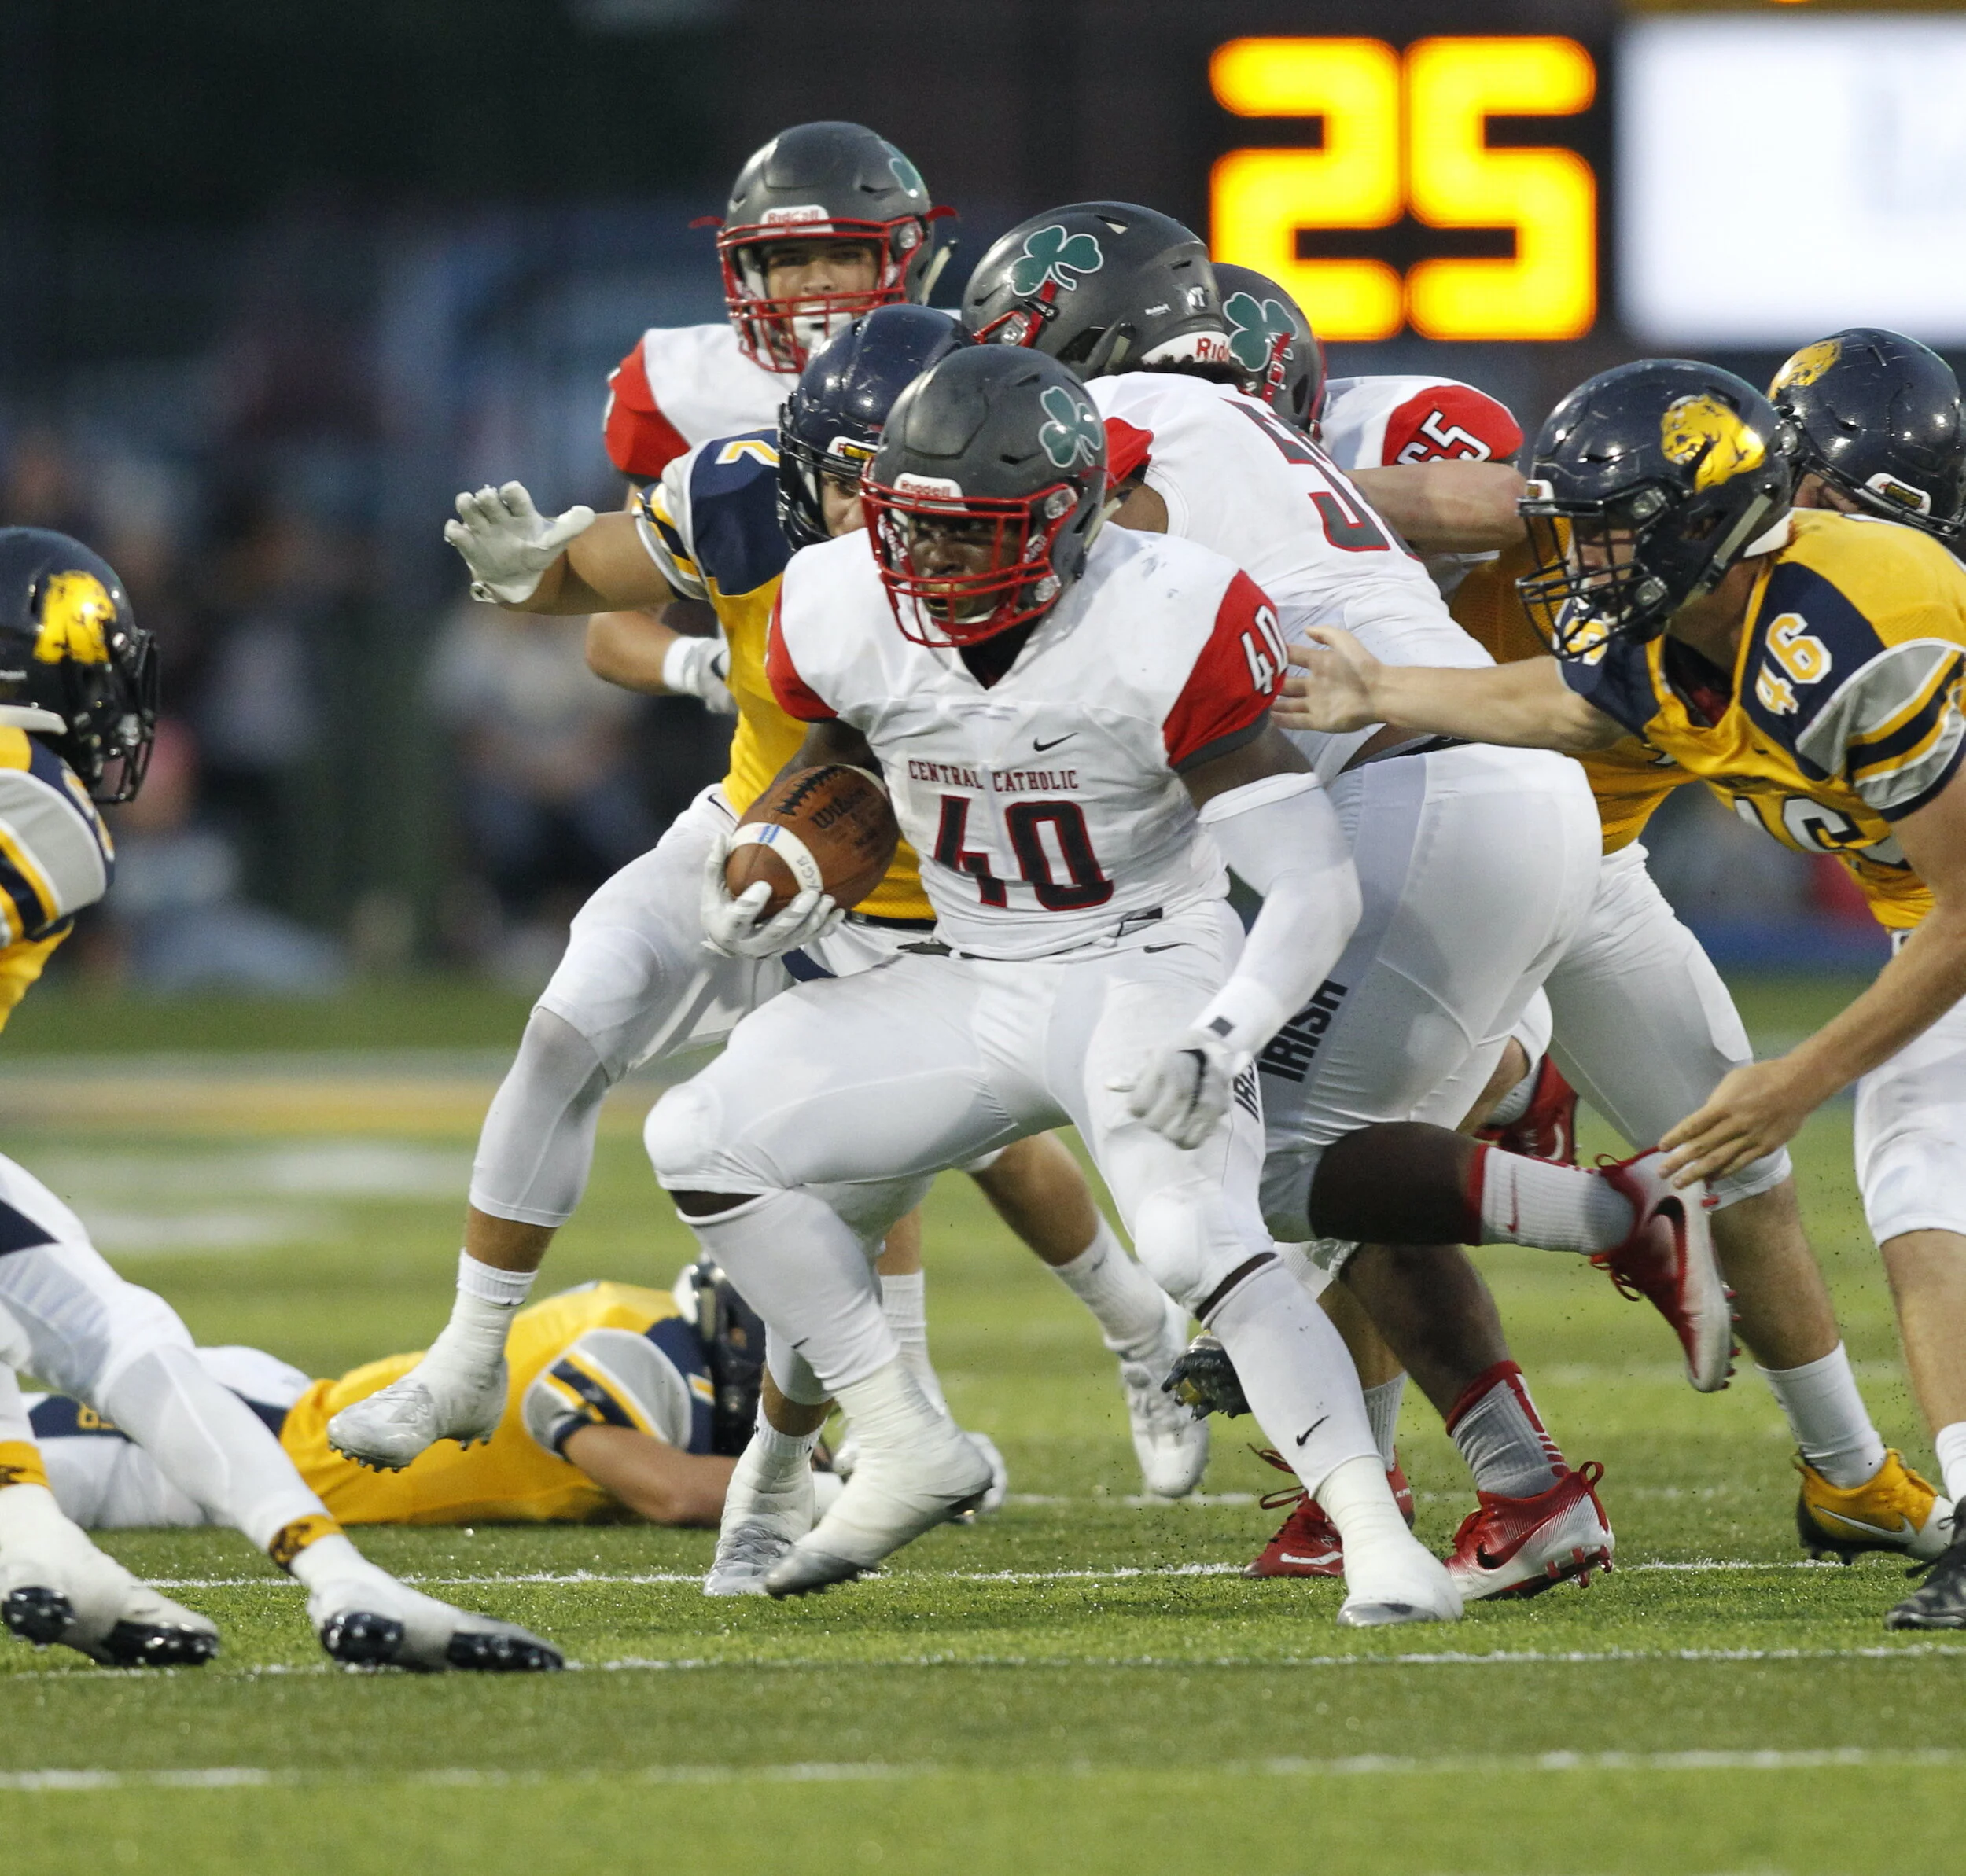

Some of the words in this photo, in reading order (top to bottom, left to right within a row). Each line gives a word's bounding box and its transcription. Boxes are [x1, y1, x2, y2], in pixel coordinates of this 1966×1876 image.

[1209, 36, 1597, 340] 25
[901, 480, 952, 498] Riddell
[1240, 605, 1290, 696] 40
[1754, 612, 1832, 715] 46
[909, 760, 985, 789] CENTRAL
[992, 770, 1079, 792] CATHOLIC
[934, 795, 1114, 912] 40
